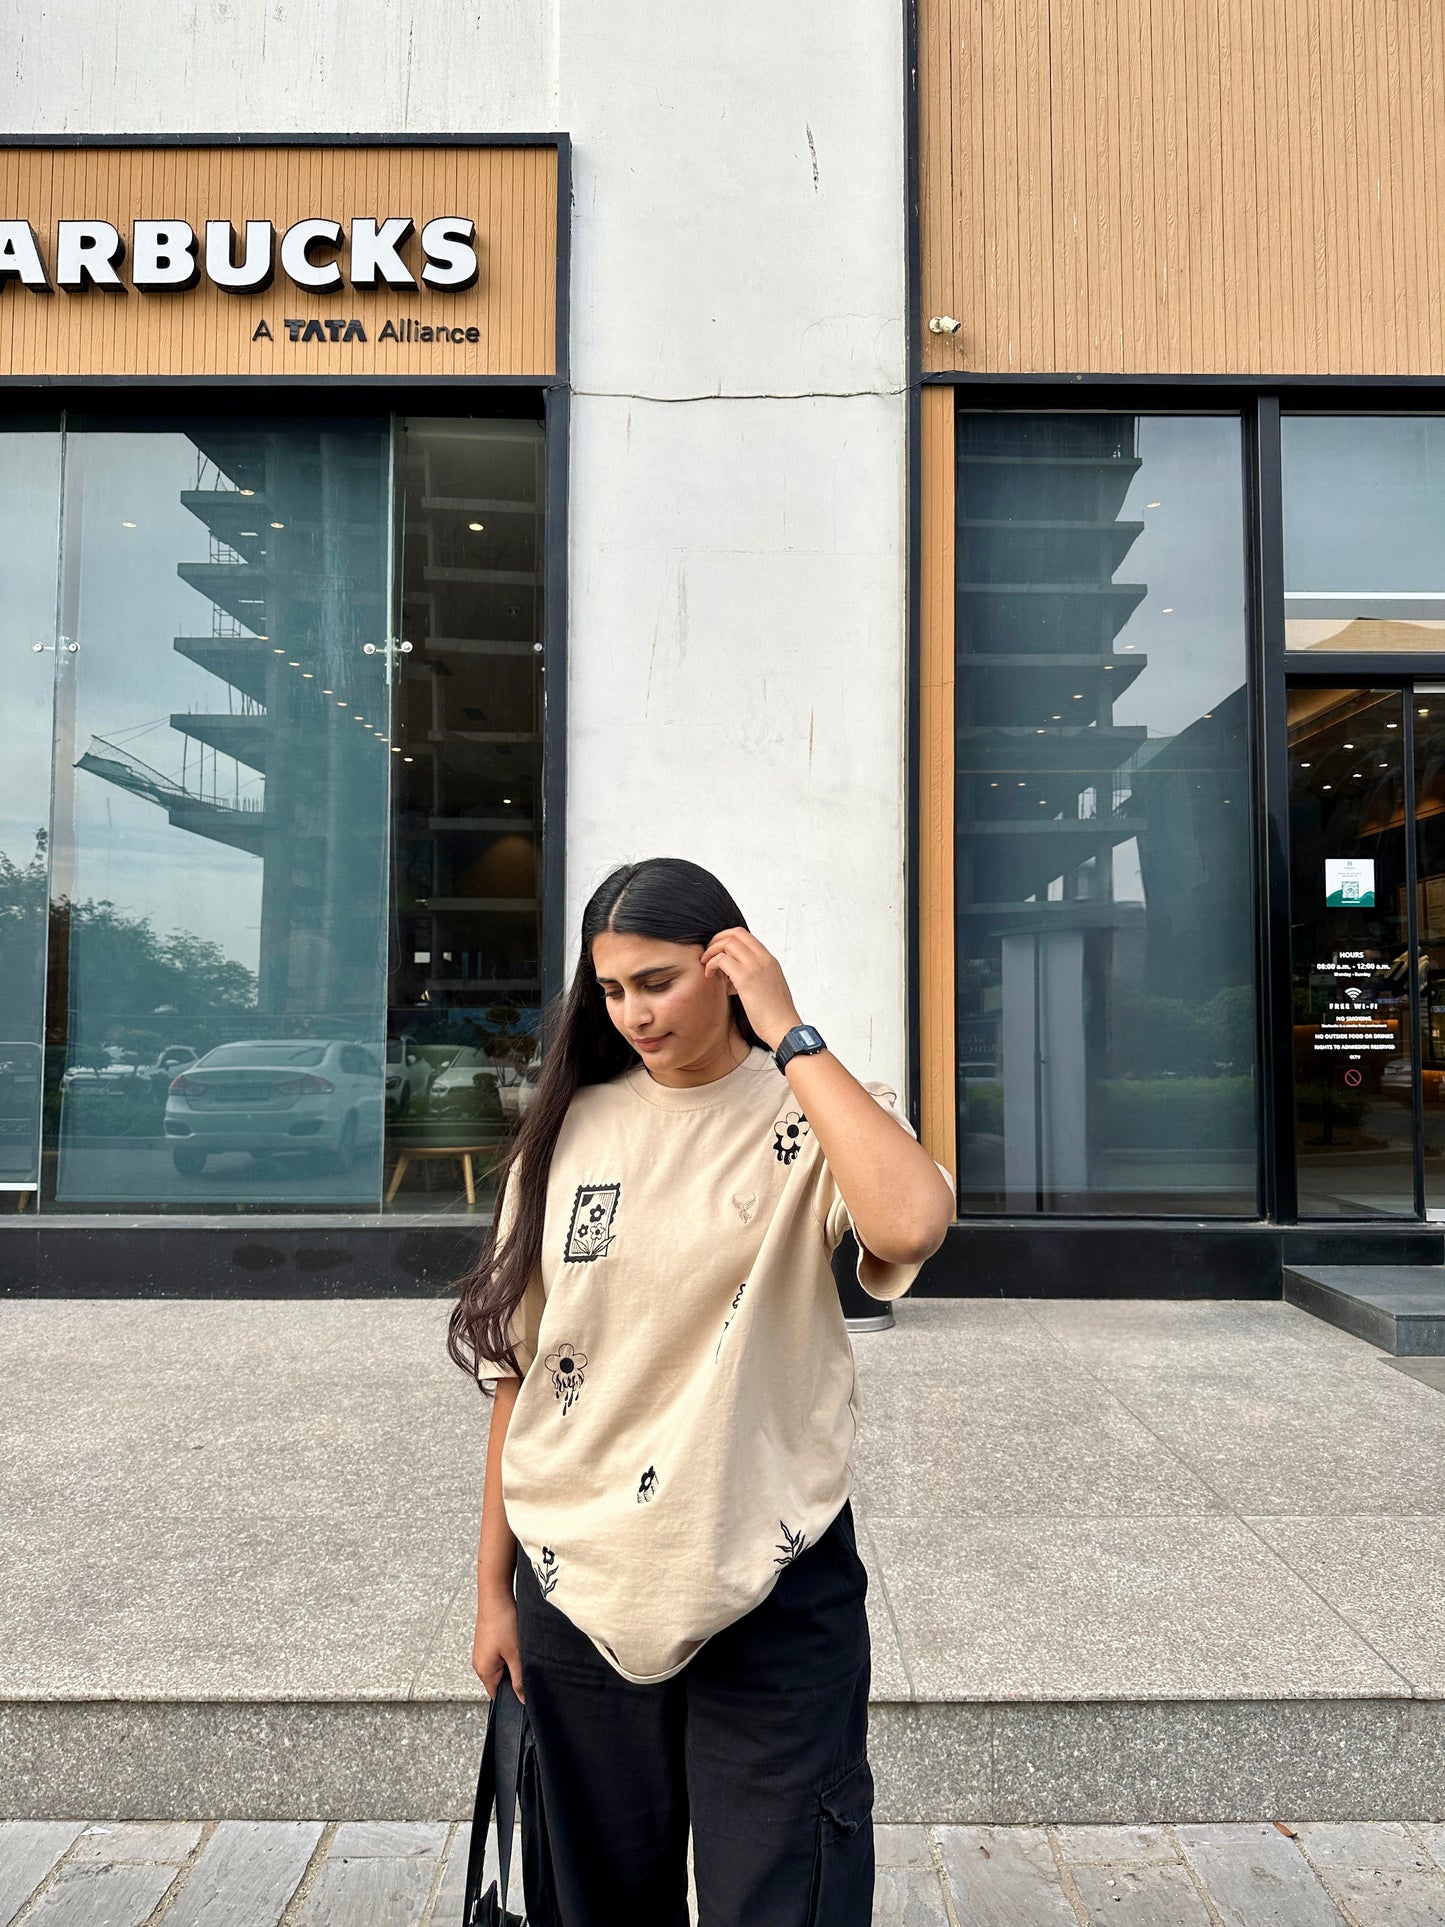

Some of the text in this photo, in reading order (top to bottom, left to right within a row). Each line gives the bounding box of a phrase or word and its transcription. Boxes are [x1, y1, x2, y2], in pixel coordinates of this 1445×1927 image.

[252, 319, 480, 343] A TATA Alliance
